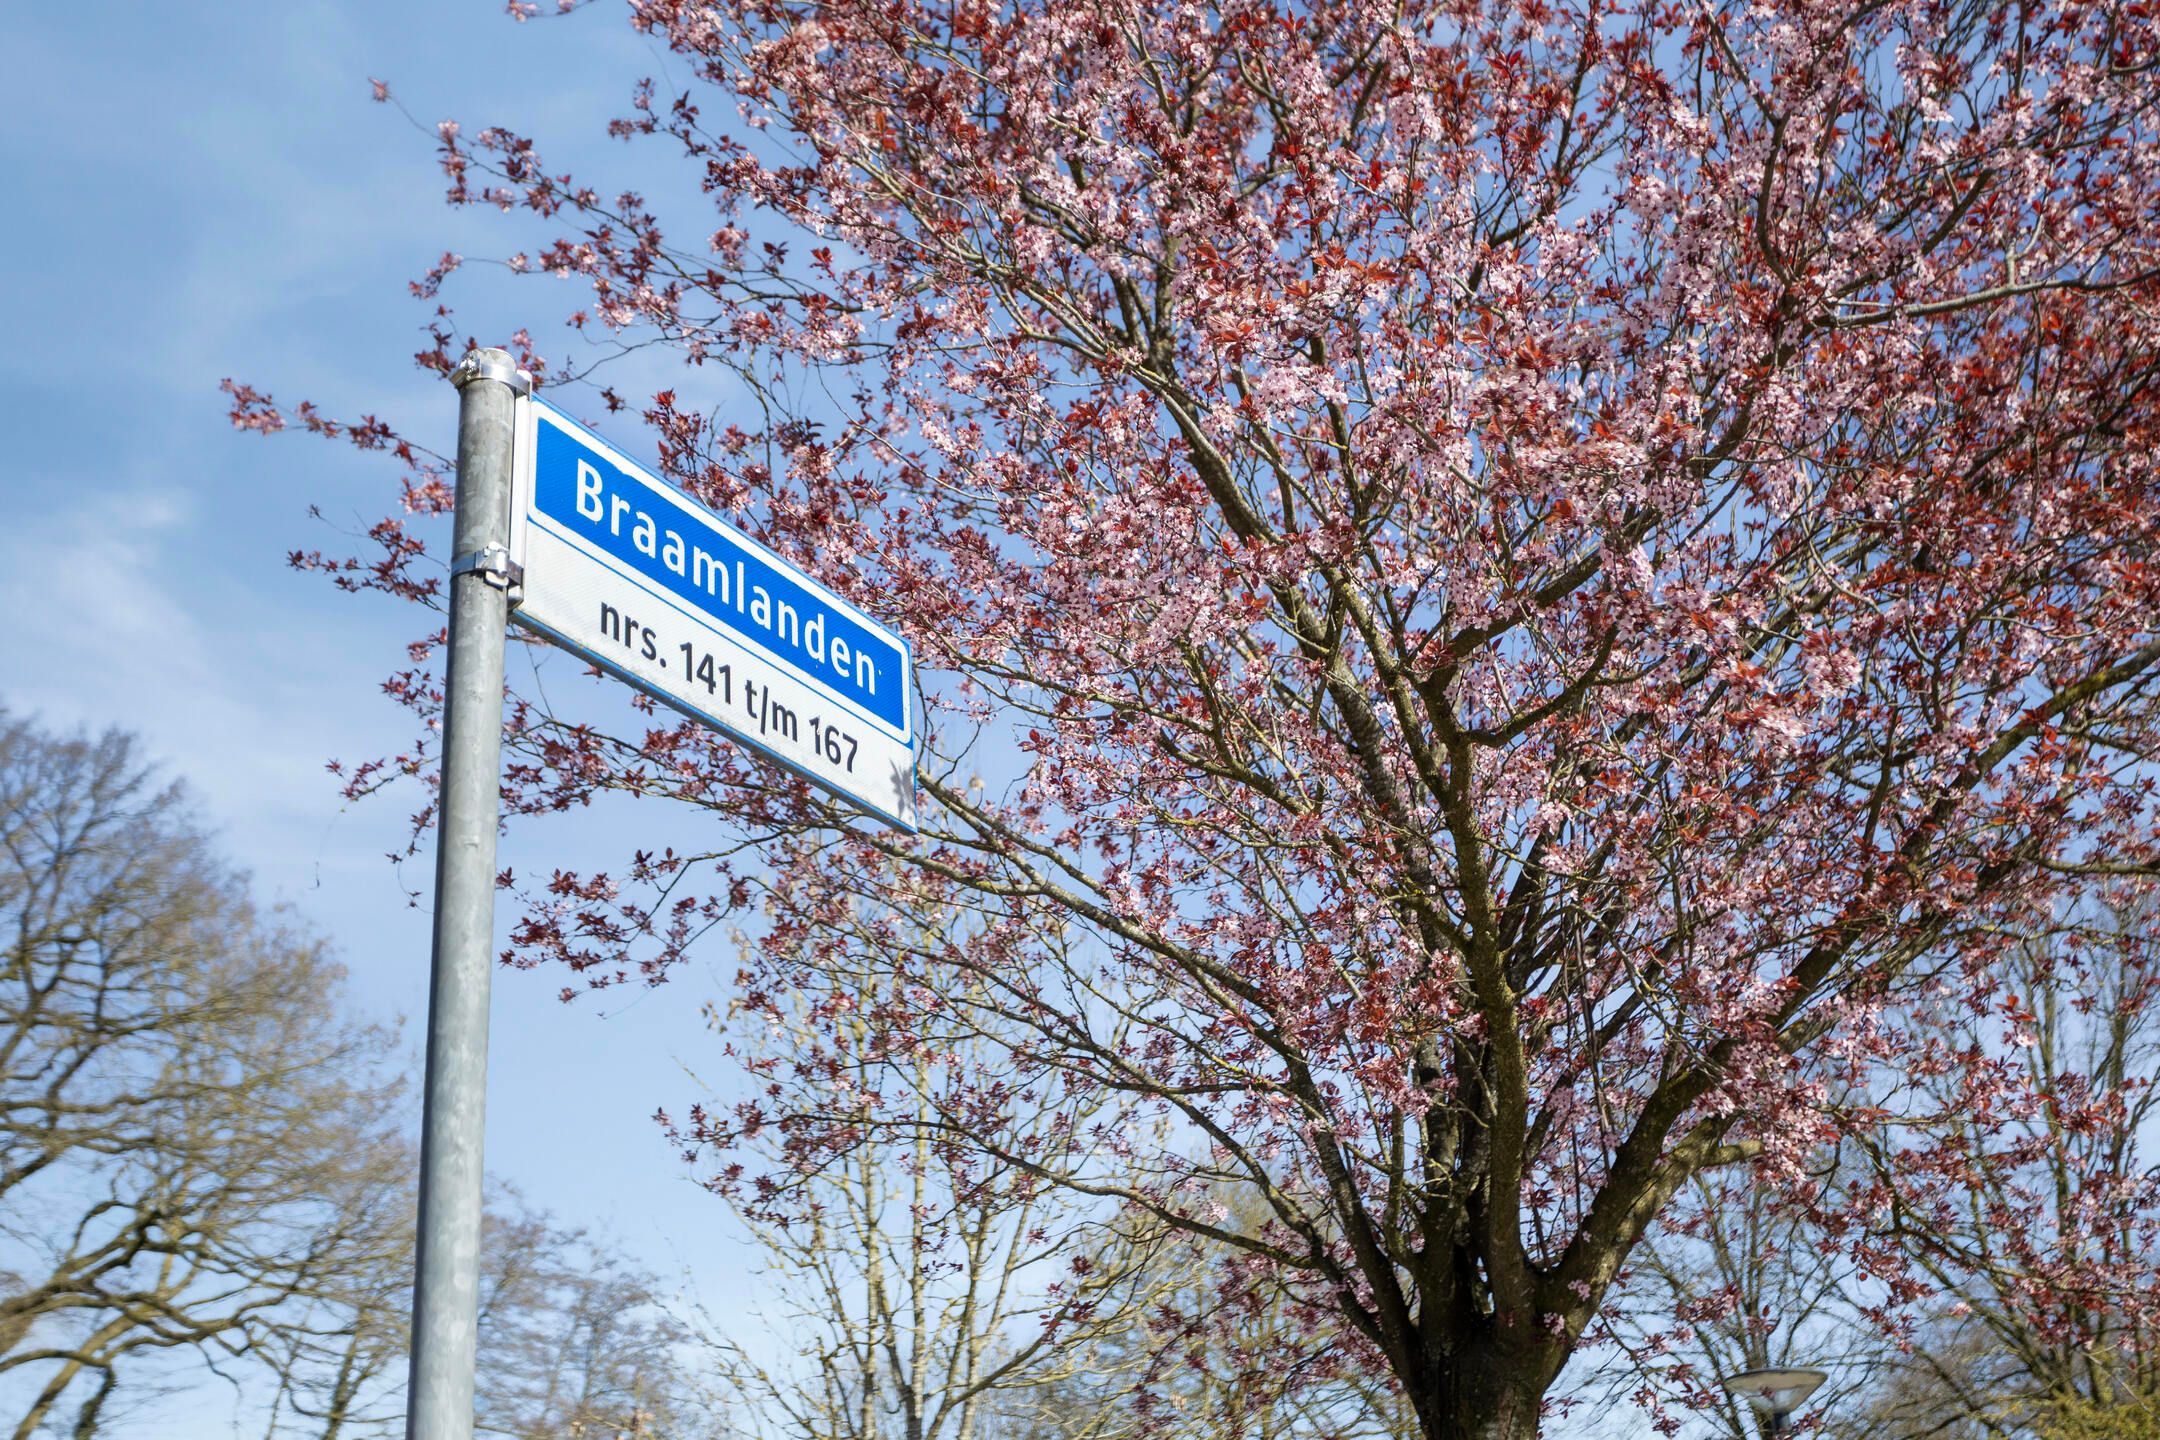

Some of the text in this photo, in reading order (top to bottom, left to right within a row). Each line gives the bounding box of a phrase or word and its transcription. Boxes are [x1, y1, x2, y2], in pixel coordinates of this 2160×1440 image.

[576, 457, 878, 696] Braamlanden
[600, 601, 858, 774] nrs. 141 t/m 167
